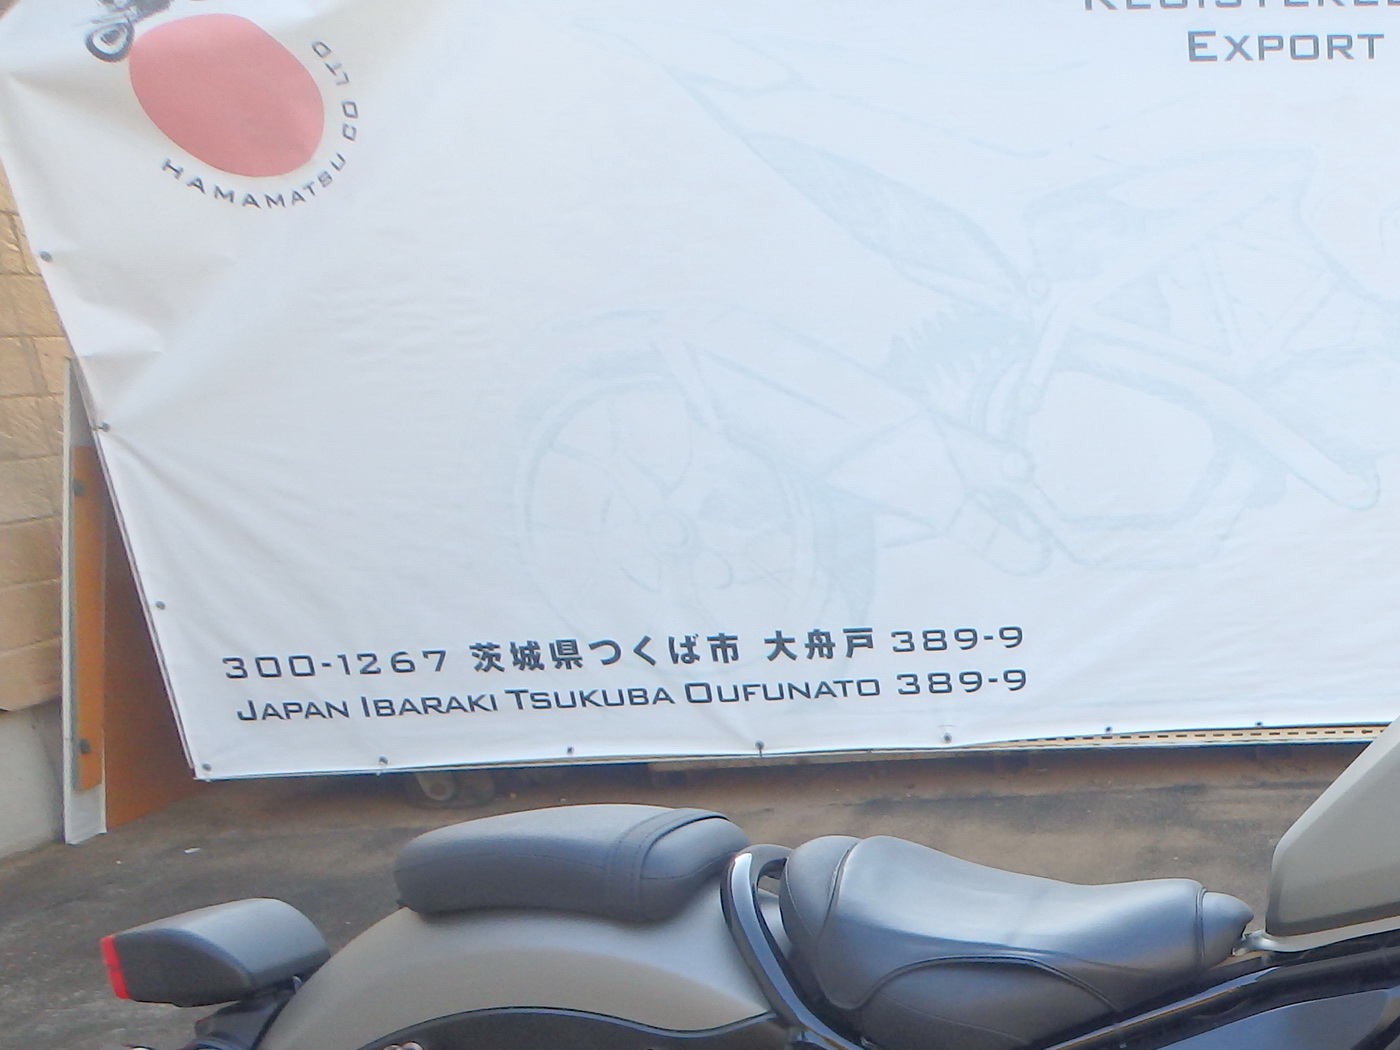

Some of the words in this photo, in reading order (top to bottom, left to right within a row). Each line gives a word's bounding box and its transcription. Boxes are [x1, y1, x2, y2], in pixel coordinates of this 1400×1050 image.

[311, 41, 350, 86] LTD
[1187, 30, 1385, 63] EXPORT
[341, 100, 359, 141] CO
[161, 152, 347, 209] HAMAMATSU
[221, 649, 448, 680] 300-1267
[468, 631, 741, 673] 茨城県つくば市
[763, 627, 875, 662] 大舟戸
[890, 625, 1024, 653] 389-9
[236, 699, 351, 722] JAPAN
[360, 693, 499, 719] IBARAKI
[503, 686, 677, 711] TSUKUBA
[684, 678, 881, 705] OUFUNATO
[896, 669, 1027, 696] 389-9
